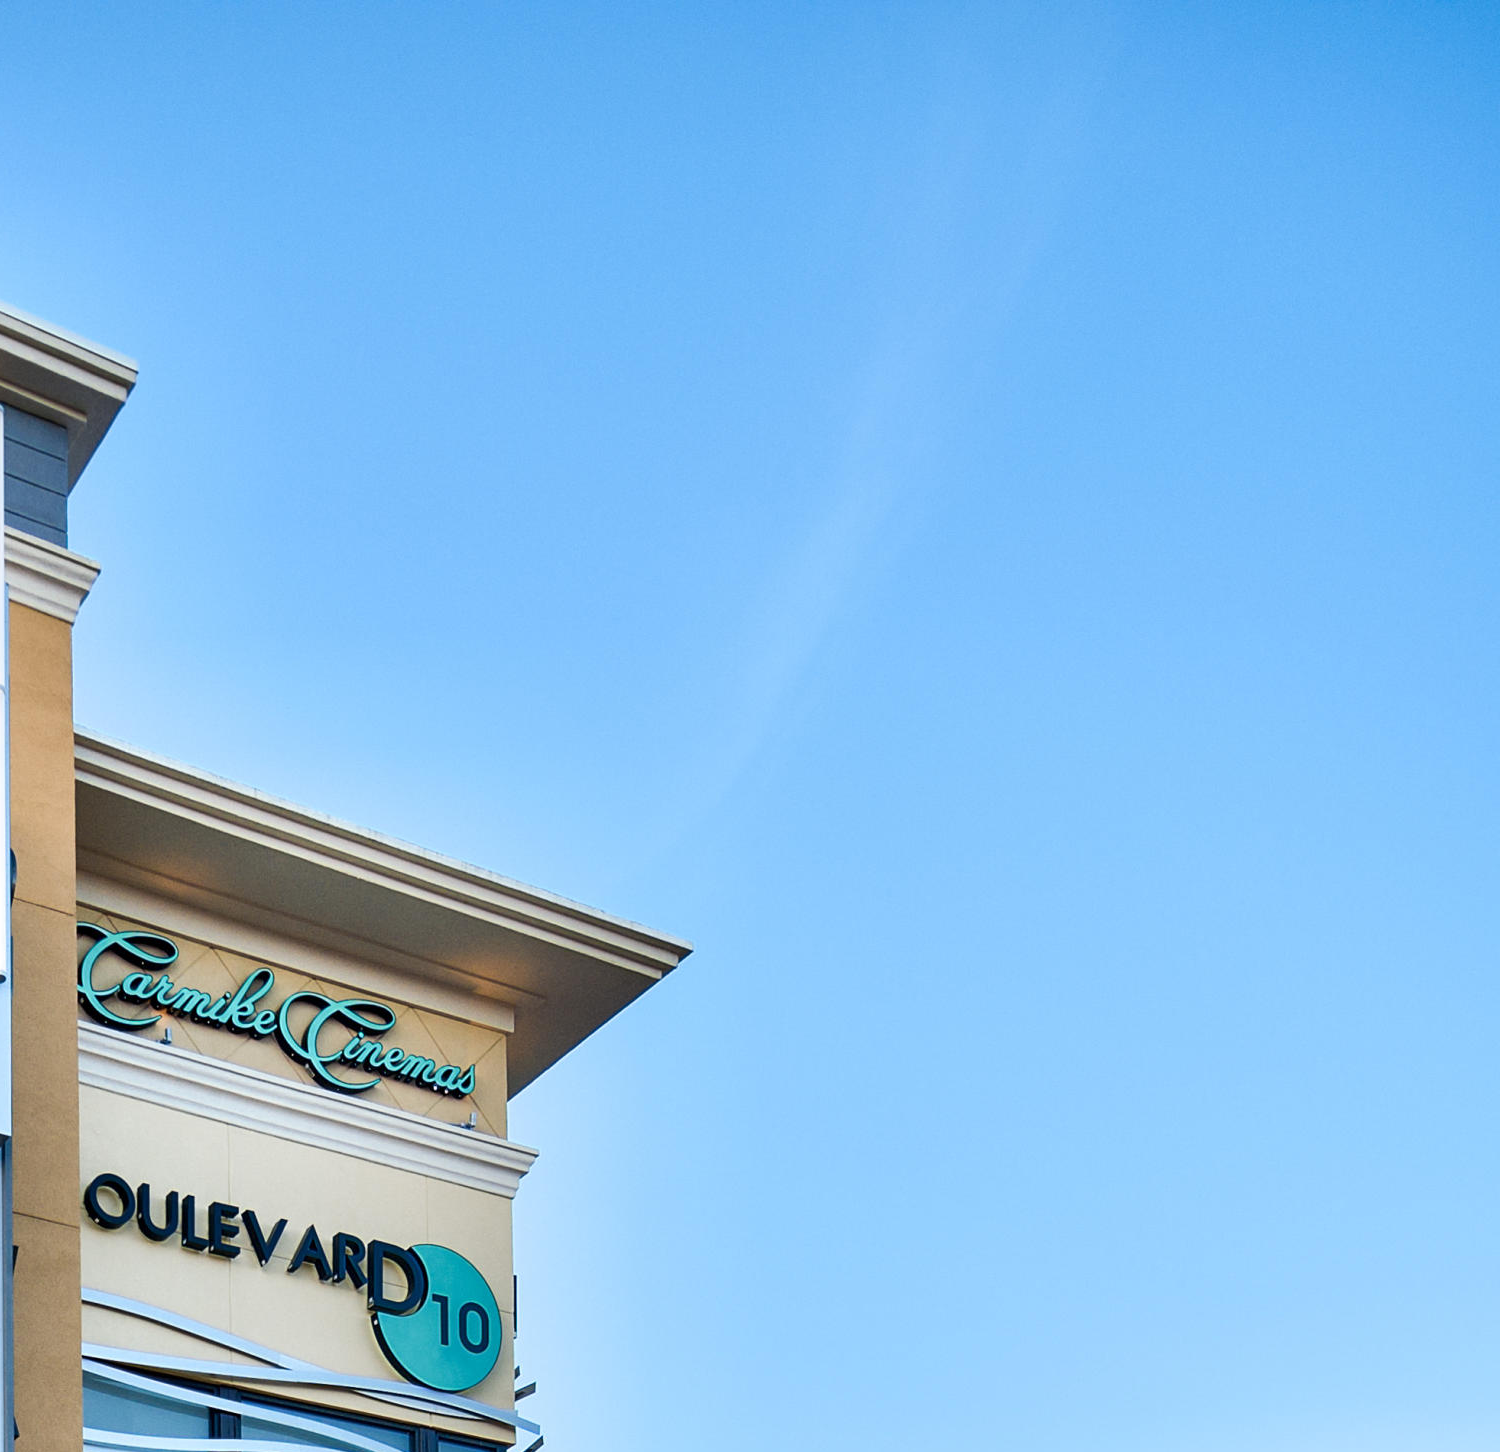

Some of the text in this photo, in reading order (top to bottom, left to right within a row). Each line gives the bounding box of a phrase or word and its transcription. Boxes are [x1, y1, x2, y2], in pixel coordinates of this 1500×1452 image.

[77, 921, 476, 1098] Carmike Cinemas
[84, 1173, 490, 1354] OULEVARD 10
